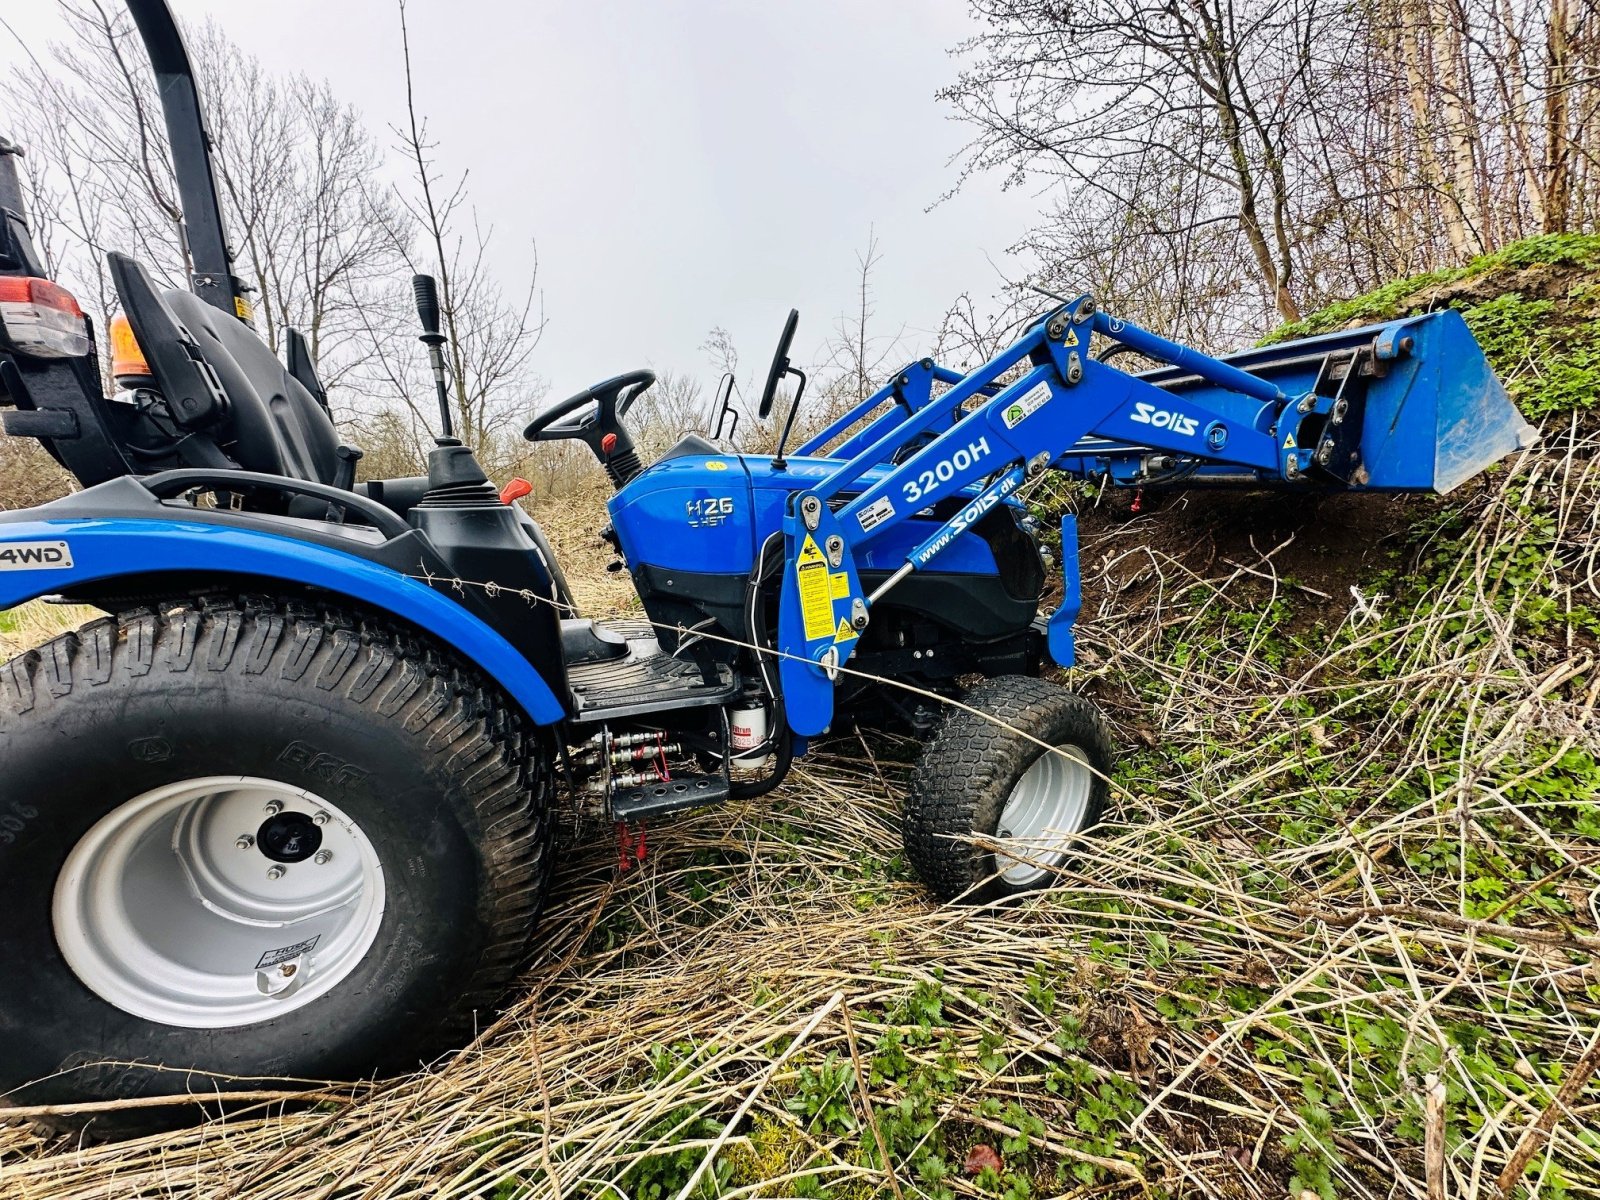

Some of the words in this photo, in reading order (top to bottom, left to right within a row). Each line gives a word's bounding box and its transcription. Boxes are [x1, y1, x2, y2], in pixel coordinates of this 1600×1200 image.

[1130, 402, 1199, 436] Solis
[902, 436, 991, 503] 3200H
[686, 497, 733, 516] H26
[0, 548, 62, 563] 4WD
